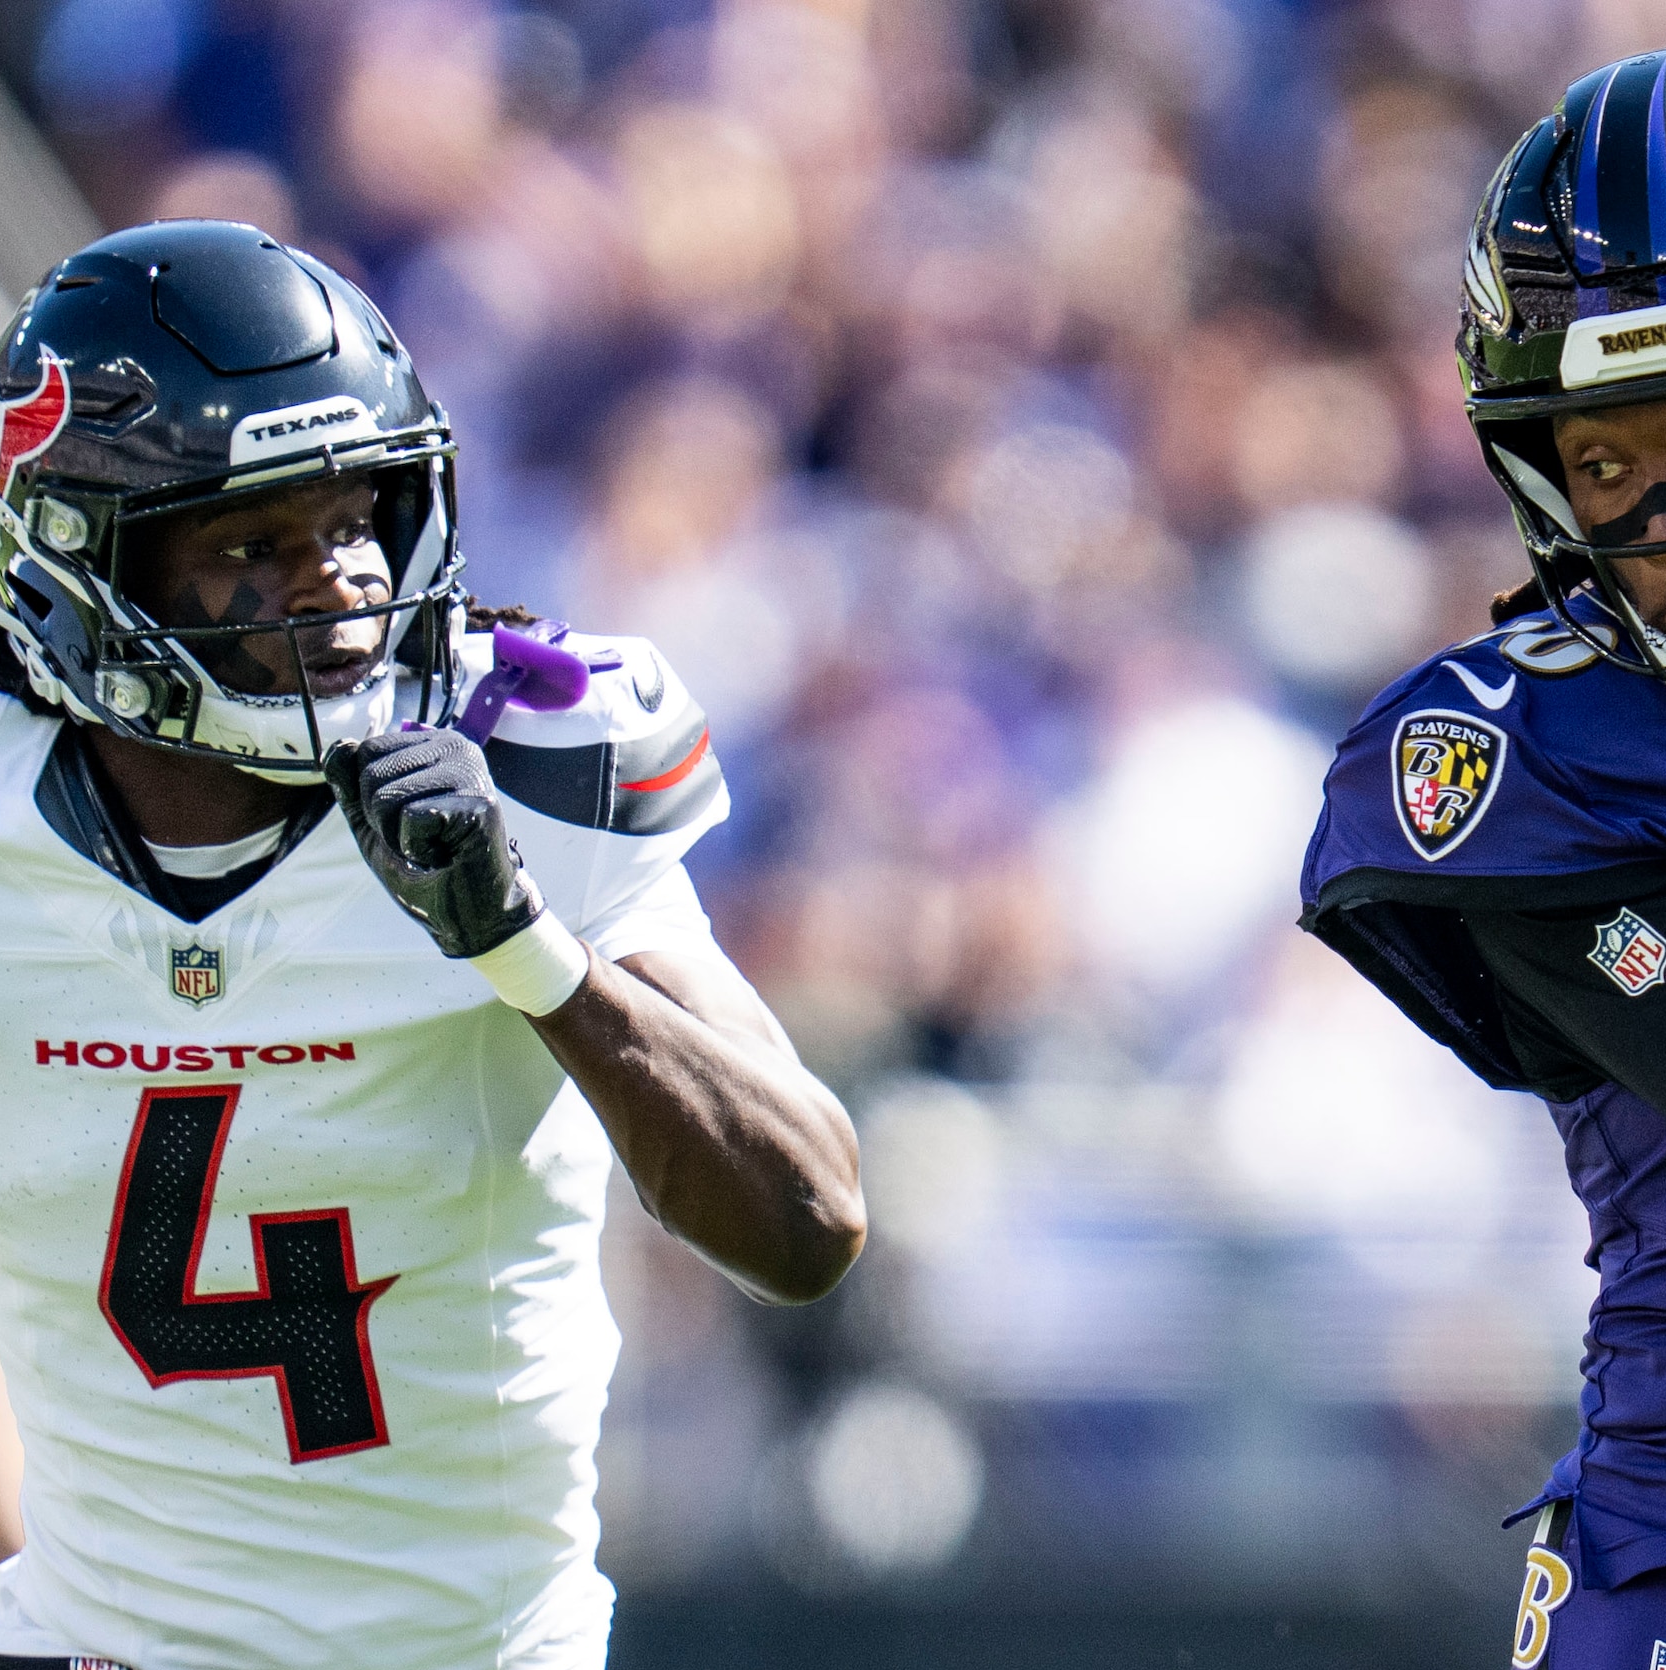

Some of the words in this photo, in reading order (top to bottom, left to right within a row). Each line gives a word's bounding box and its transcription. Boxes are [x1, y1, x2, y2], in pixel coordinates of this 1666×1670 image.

[246, 406, 360, 442] TEXANS
[1408, 721, 1491, 750] RAVENS
[1615, 936, 1664, 988] NFL
[176, 968, 217, 997] NFL
[35, 1038, 356, 1072] HOUSTON
[98, 1083, 401, 1464] 4
